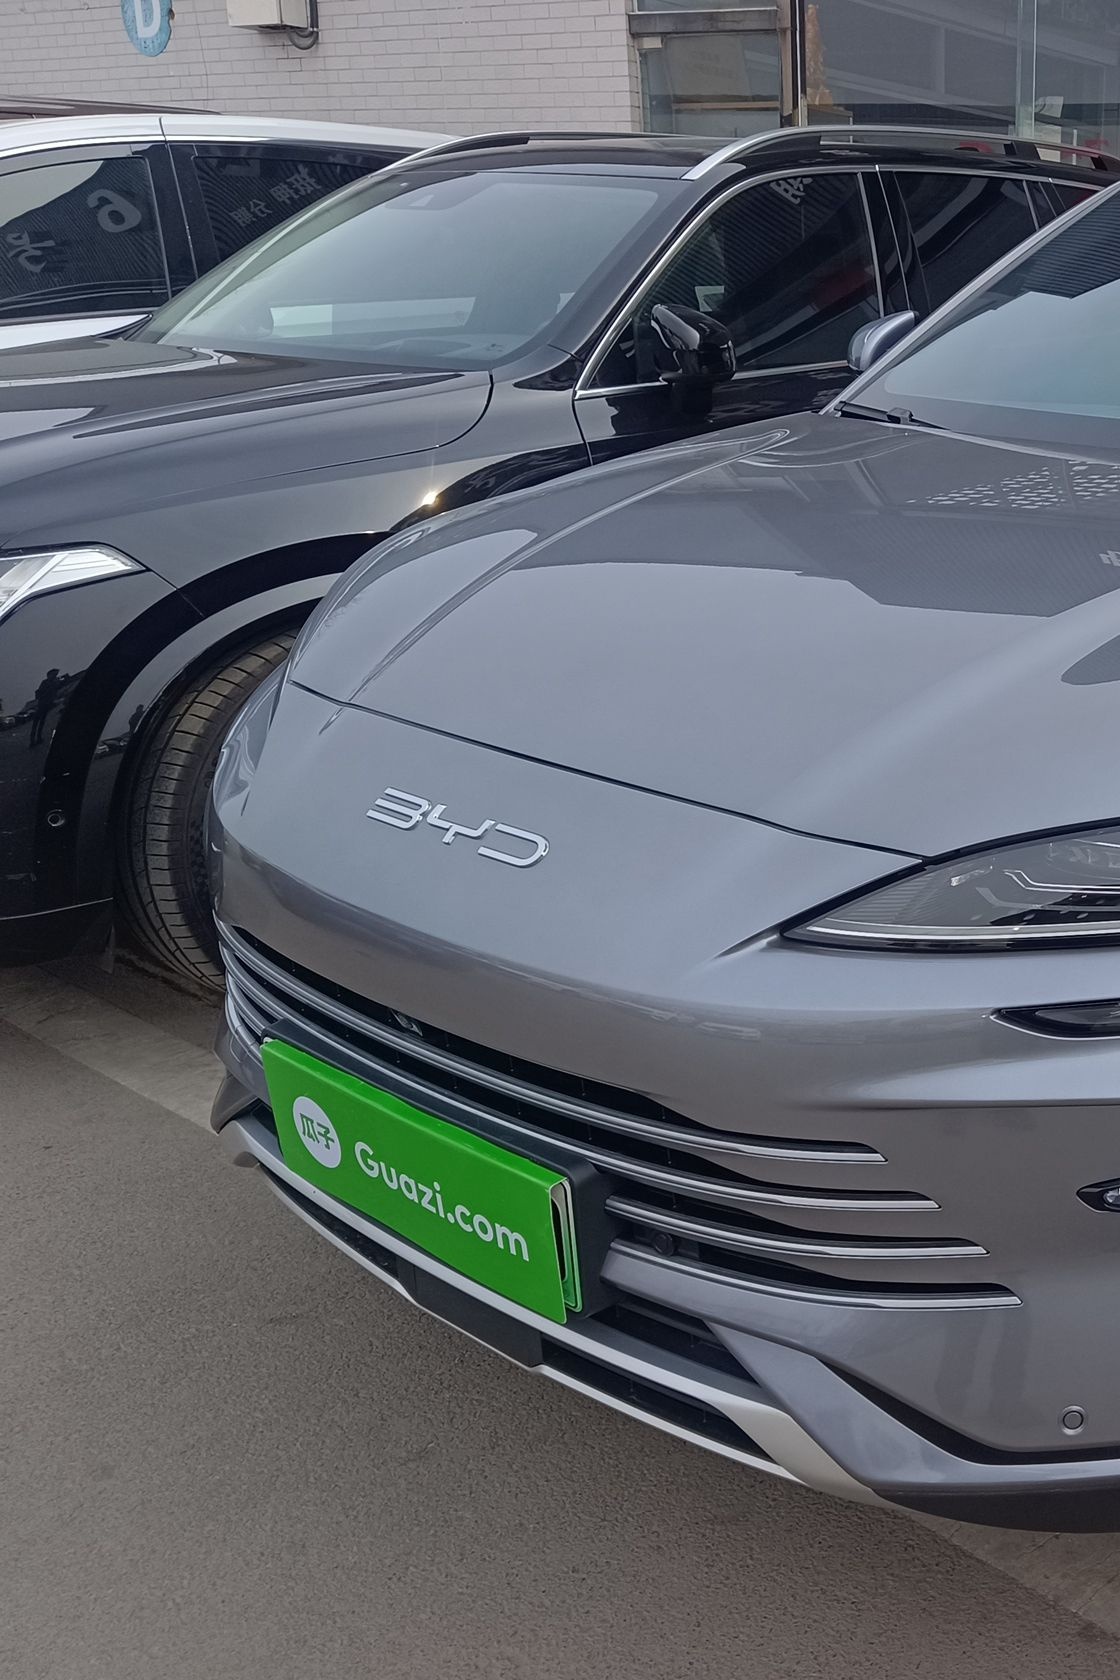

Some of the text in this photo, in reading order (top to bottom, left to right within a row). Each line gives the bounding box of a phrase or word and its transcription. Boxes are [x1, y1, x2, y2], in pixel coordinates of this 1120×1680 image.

[366, 786, 549, 869] BYD
[299, 1111, 335, 1151] 瓜子
[354, 1140, 530, 1262] Guazi.com
